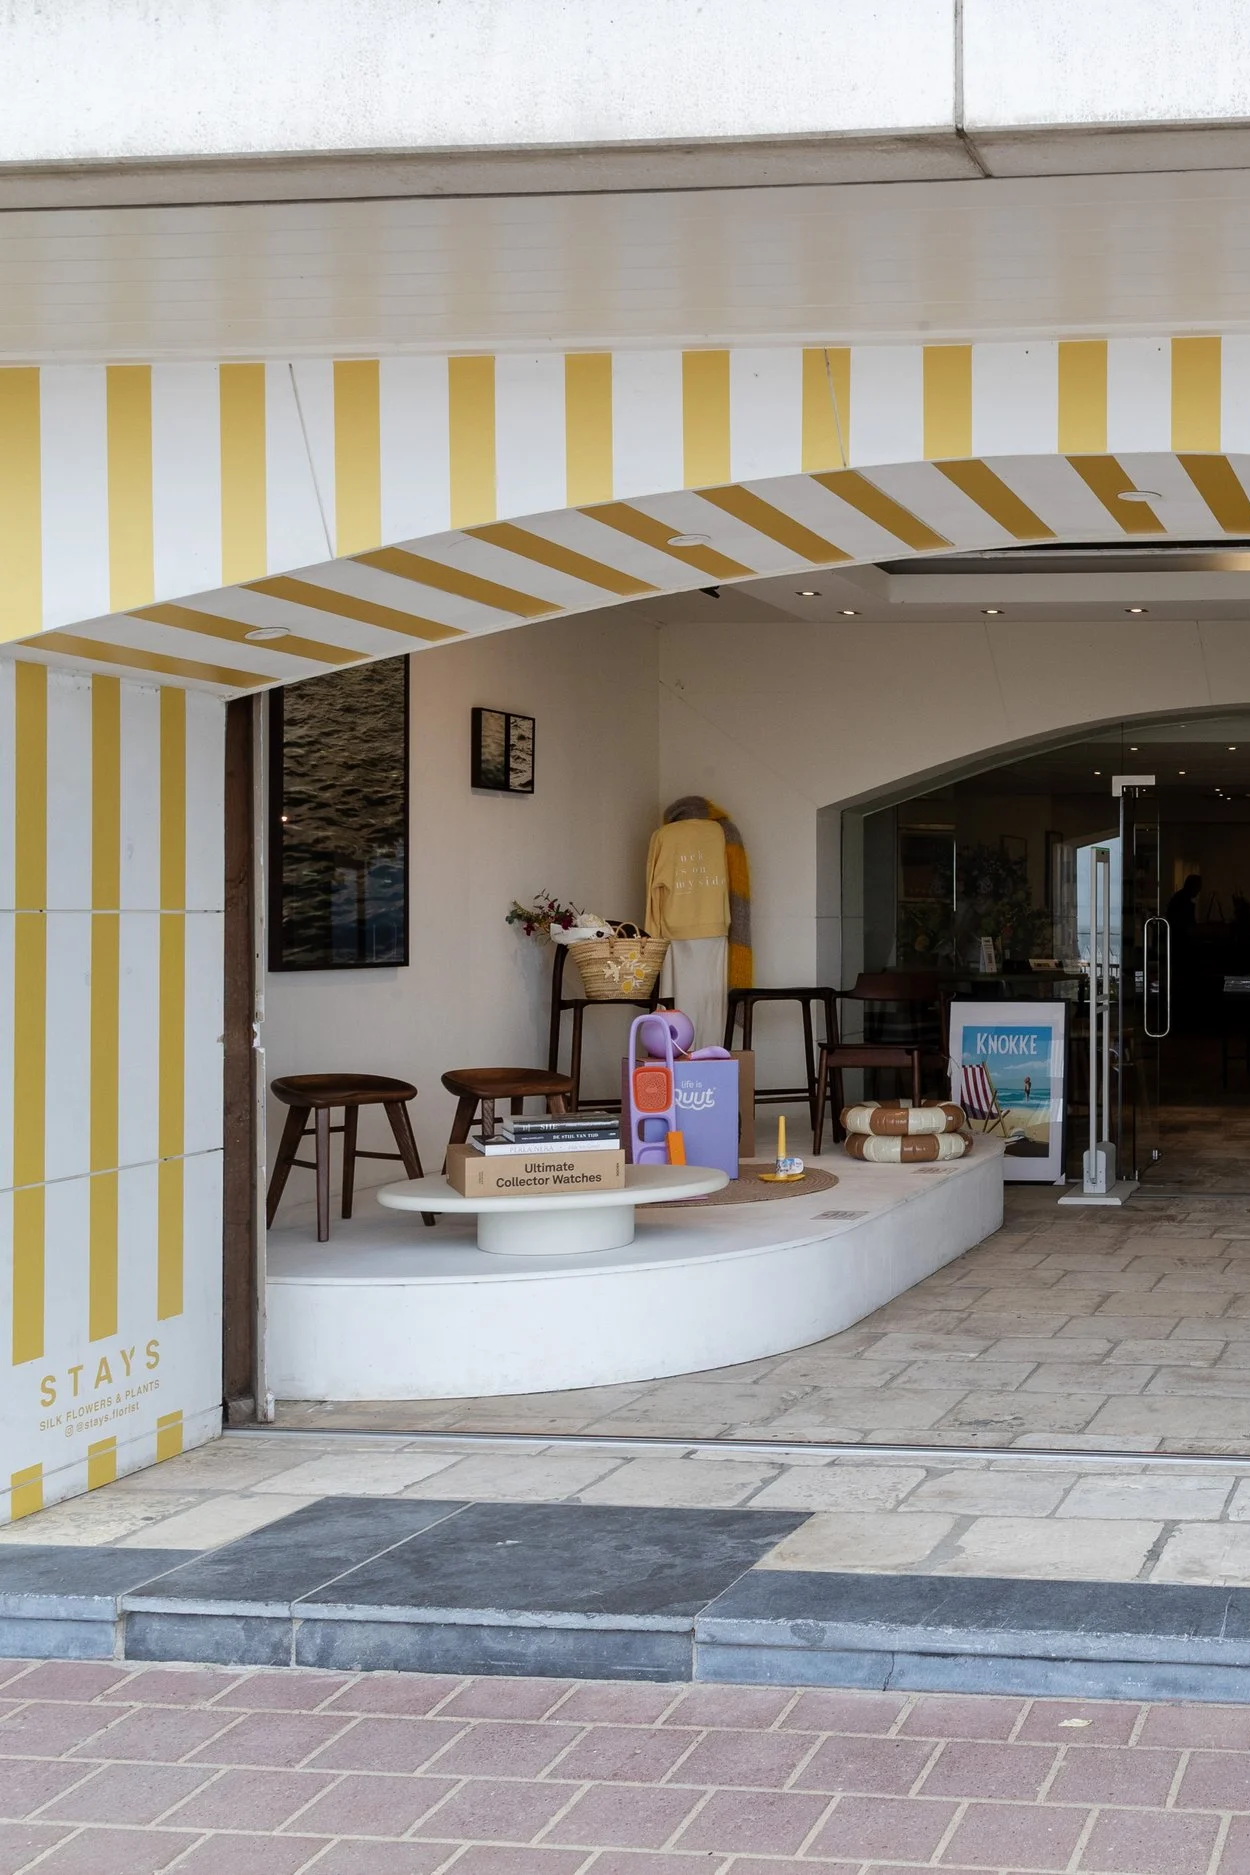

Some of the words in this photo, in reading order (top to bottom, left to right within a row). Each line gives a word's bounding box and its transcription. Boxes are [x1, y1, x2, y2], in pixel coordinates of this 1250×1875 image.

[676, 880, 694, 890] my
[976, 1032, 1038, 1055] KNOKKE
[524, 1162, 575, 1174] Ultimate
[496, 1175, 551, 1188] Collector
[553, 1173, 602, 1185] Watches
[40, 1339, 160, 1408] STAYS
[39, 1413, 63, 1431] SILK
[66, 1396, 112, 1422] FLOWERS
[115, 1393, 122, 1404] &
[125, 1379, 160, 1400] PLANTS
